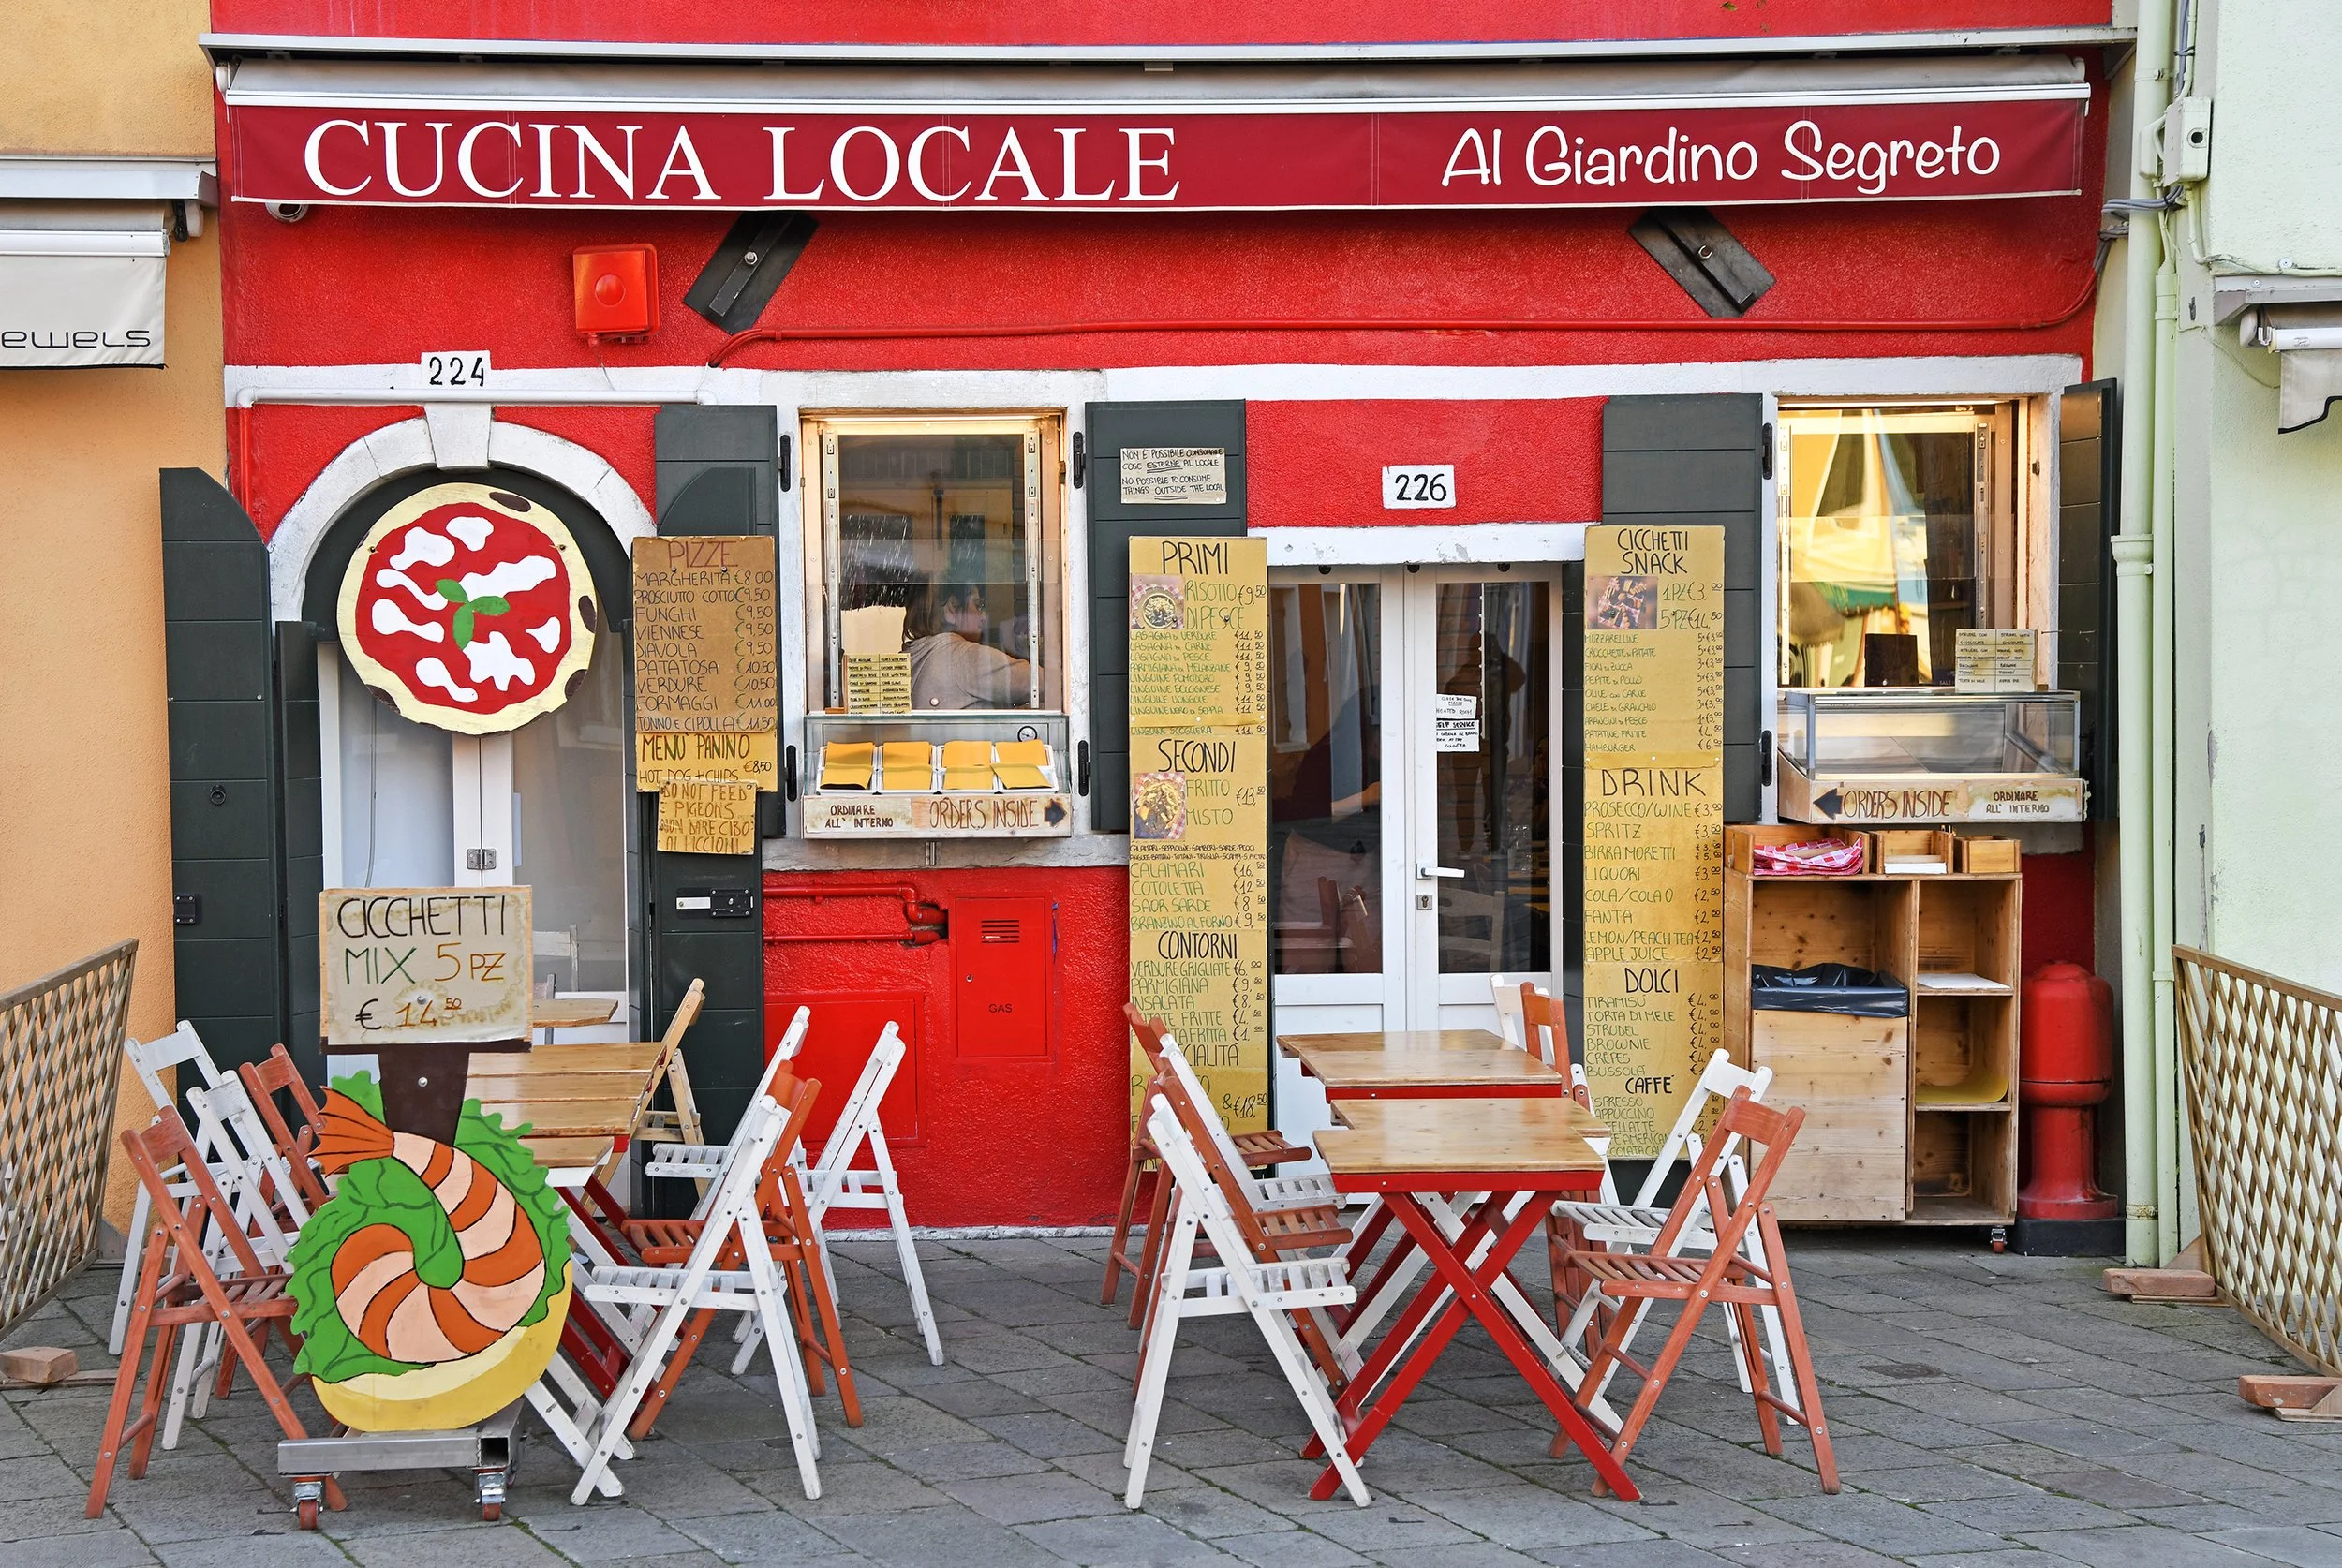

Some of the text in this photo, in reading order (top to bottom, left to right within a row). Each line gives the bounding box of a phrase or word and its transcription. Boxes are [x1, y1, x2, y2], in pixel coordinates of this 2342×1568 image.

[304, 119, 1179, 202] CUCINA LOCALE
[1442, 120, 2001, 195] Al Giardino Segreto
[430, 357, 483, 387] 224
[1122, 451, 1138, 460] NON
[1151, 449, 1184, 458] POSSIBILE
[1147, 460, 1180, 468] ESTERNE
[1136, 477, 1168, 485] POSSIBLE
[1180, 474, 1211, 483] CONSUME
[1395, 474, 1446, 501] 226
[1617, 528, 1688, 551] CICCHETTI
[668, 541, 738, 568] PIZZE
[1162, 540, 1228, 575] PRIMI
[1621, 552, 1687, 574] SNACK
[635, 571, 731, 586] MARGHERITA
[634, 590, 734, 604] PROSCIUTTO COTTO
[1186, 580, 1237, 602] RISOTTO
[635, 606, 696, 622] FUNGHI
[1186, 606, 1245, 630] DI PESCE
[635, 625, 704, 640] VIENNESE
[636, 643, 697, 658] DIAVOLA
[1130, 643, 1171, 651] LASAGNA
[1130, 653, 1211, 661] LASAGNA PESCE
[637, 660, 719, 675] PATATOSA
[637, 676, 707, 693] VERDURE
[1130, 673, 1170, 683] LINGUINE
[1130, 685, 1171, 693] LINGUINE
[636, 695, 718, 711] FORMAGGI
[1130, 695, 1167, 703] LINGUINE
[1130, 705, 1169, 715] LINGUINE
[637, 717, 672, 732] TONNO
[685, 716, 734, 732] CIPOLLA
[694, 733, 749, 760] PANINO
[1585, 744, 1635, 752] HAMBURGER
[1158, 739, 1236, 773] SECONDI
[640, 769, 691, 784] HOT DOG
[1602, 768, 1706, 796] DRINK
[663, 782, 748, 802] DO NOT FEED
[1186, 779, 1230, 797] FRITTO
[1994, 791, 2038, 802] ORDINARE
[674, 801, 734, 819] PIGEONS
[831, 805, 876, 816] ORDINARE
[1585, 802, 1692, 818] PROSECCO/WINE
[1844, 790, 1953, 819] ORDERS INSIDE
[2009, 804, 2050, 813] INTERNO
[930, 798, 1039, 830] ORDERS INSIDE
[1186, 808, 1234, 825] MISTO
[689, 820, 716, 835] DARE
[719, 821, 749, 836] CIBO
[854, 817, 894, 828] INTERNO
[1586, 822, 1641, 839] SPRITZ
[684, 836, 738, 852] PICCIONI
[1585, 846, 1676, 861] BIRRA MORETTI
[1131, 862, 1205, 878] CALAMARI
[1585, 867, 1640, 881] LIQUORI
[1132, 880, 1204, 895] COTOLETTA
[1585, 888, 1662, 903] COLA/COLA
[1132, 899, 1211, 913] SAOR SARDE
[337, 895, 506, 939] CICCHETTI
[1131, 915, 1233, 932] BRANZINO AL FORNO
[1585, 910, 1633, 924] FANTA
[1158, 931, 1238, 959] CONTORNI
[1585, 930, 1694, 945] LEMON/PEACH TEA
[1586, 947, 1668, 961] APPLE JUICE
[345, 942, 507, 984] MIX 5 PZ
[1131, 960, 1231, 977] VERDURE GRIGLIATE
[1131, 977, 1208, 994] PARMIGIANA
[1624, 968, 1678, 993] DOLCI
[988, 1003, 1013, 1013] GAS
[1132, 996, 1194, 1011] INSALATA
[1181, 1010, 1223, 1027] FRITTE
[1586, 1011, 1675, 1022] TORTA DI MELE
[1190, 1028, 1226, 1043] FRITTA
[1587, 1024, 1638, 1036] STRUDEL
[1587, 1038, 1651, 1050] BROWNIE
[1593, 1096, 1643, 1107] SPRESSO
[1595, 1108, 1654, 1119] APPUCCINO
